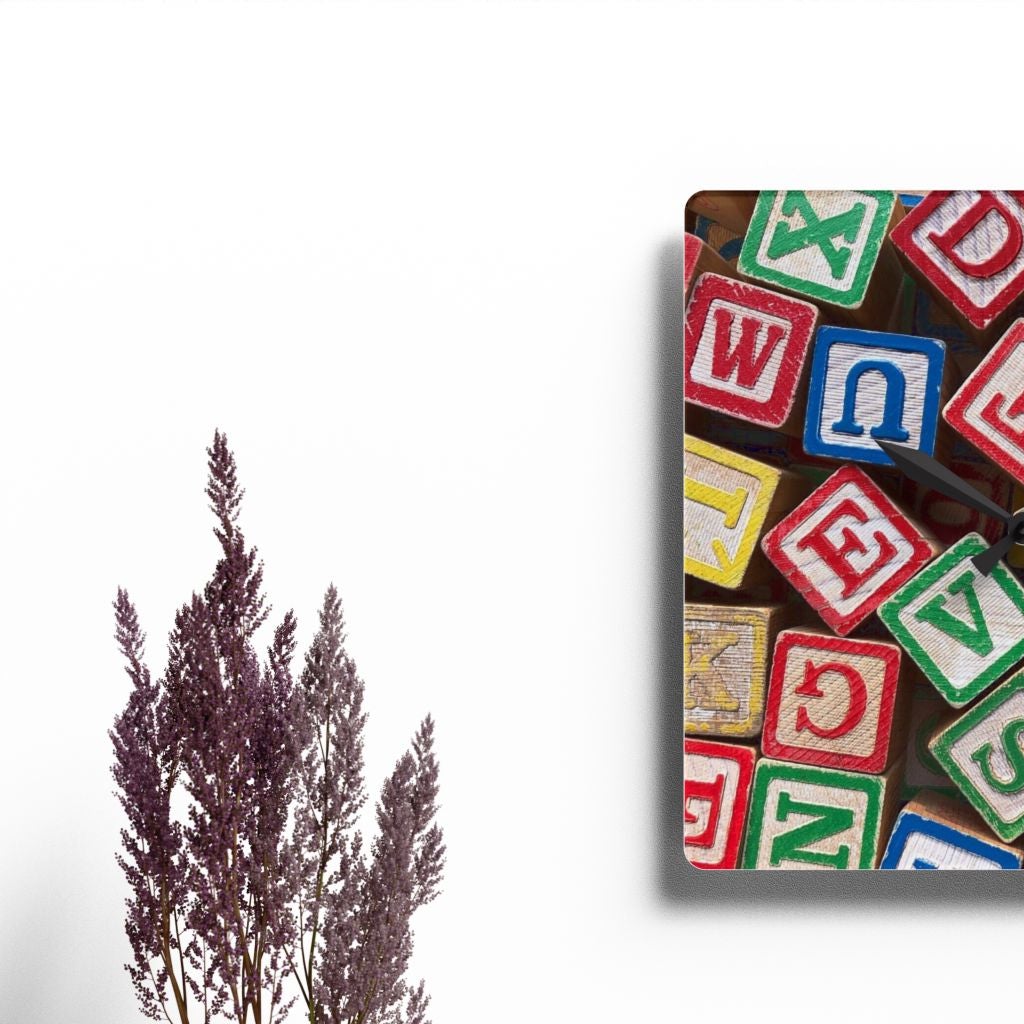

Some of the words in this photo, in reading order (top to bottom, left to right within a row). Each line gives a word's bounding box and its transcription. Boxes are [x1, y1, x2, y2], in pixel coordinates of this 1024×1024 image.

[928, 190, 1023, 278] D
[711, 308, 785, 390] W
[832, 359, 909, 442] U
[797, 498, 898, 599] E
[915, 570, 993, 658] V
